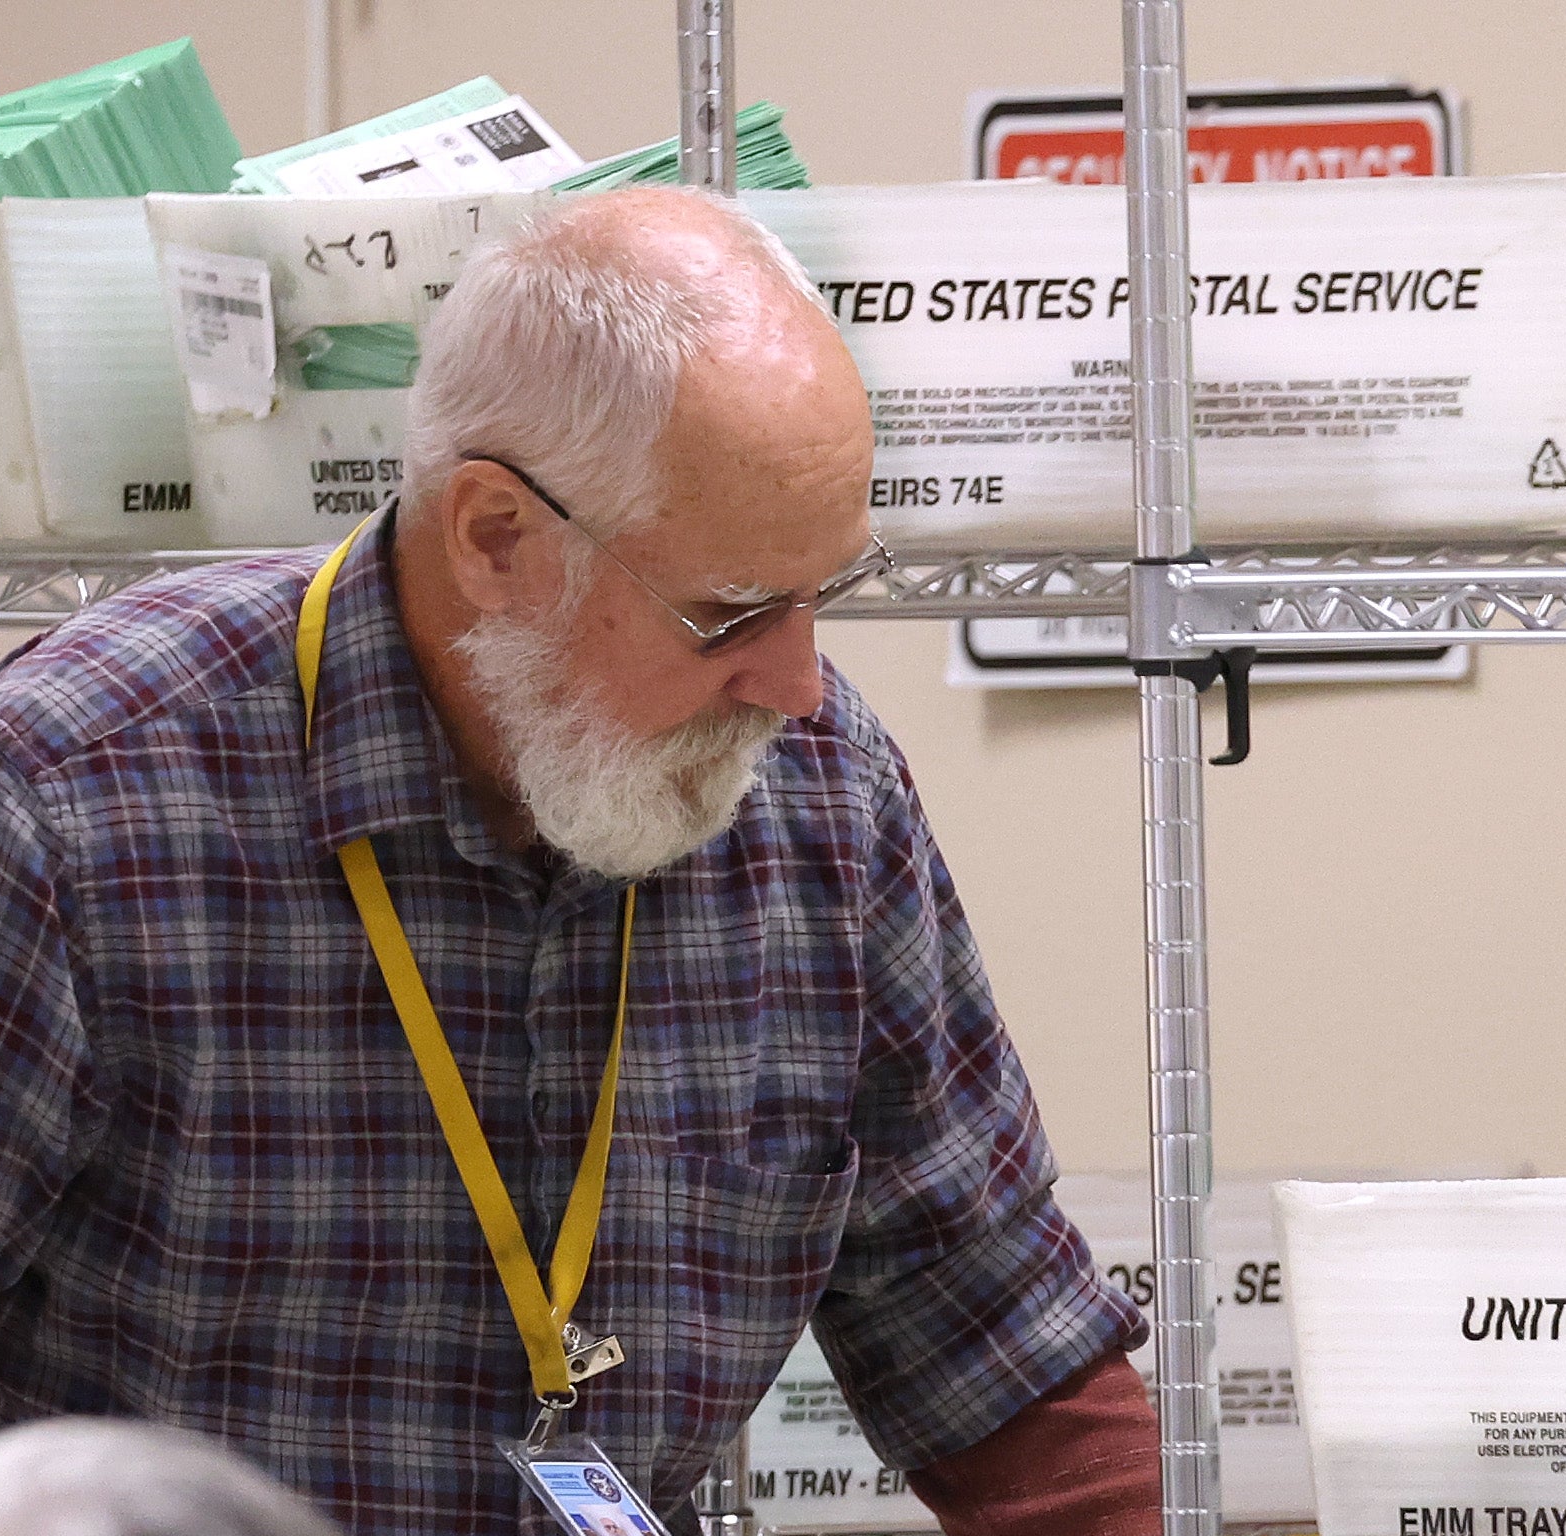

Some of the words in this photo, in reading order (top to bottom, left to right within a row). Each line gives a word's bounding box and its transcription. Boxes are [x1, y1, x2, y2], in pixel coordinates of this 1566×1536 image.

[819, 279, 914, 323] TED
[926, 279, 1093, 322] STATES
[1107, 276, 1278, 320] PSTAL
[1294, 269, 1483, 315] SERVICE
[1071, 359, 1129, 378] WARN
[311, 459, 374, 482] UNITED
[124, 483, 192, 513] EMM
[869, 478, 940, 508] EIRS
[951, 476, 1004, 504] 74E
[1471, 1410, 1497, 1425] THIS
[1484, 1427, 1510, 1441] FOR
[1513, 1427, 1536, 1441] ANY
[784, 1467, 852, 1498] TRAY
